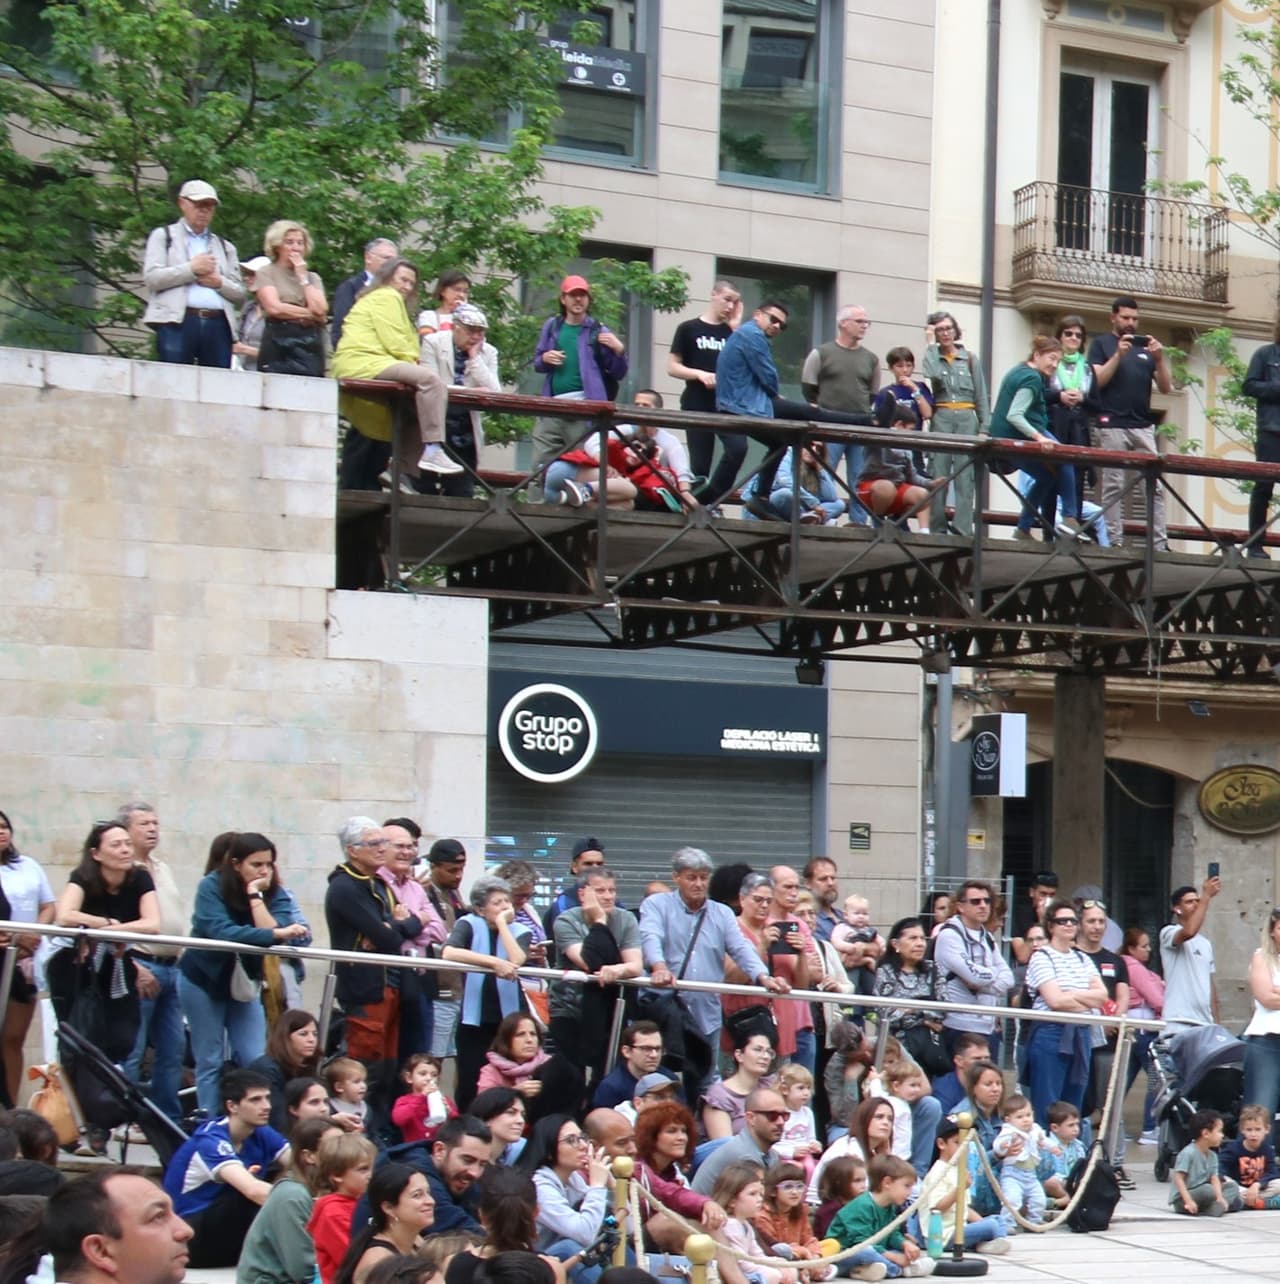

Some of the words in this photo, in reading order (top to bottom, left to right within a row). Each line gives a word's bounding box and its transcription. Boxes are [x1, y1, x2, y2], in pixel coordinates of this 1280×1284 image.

[515, 710, 582, 736] Grupo
[523, 730, 574, 755] stop
[721, 739, 771, 751] MEDICINA
